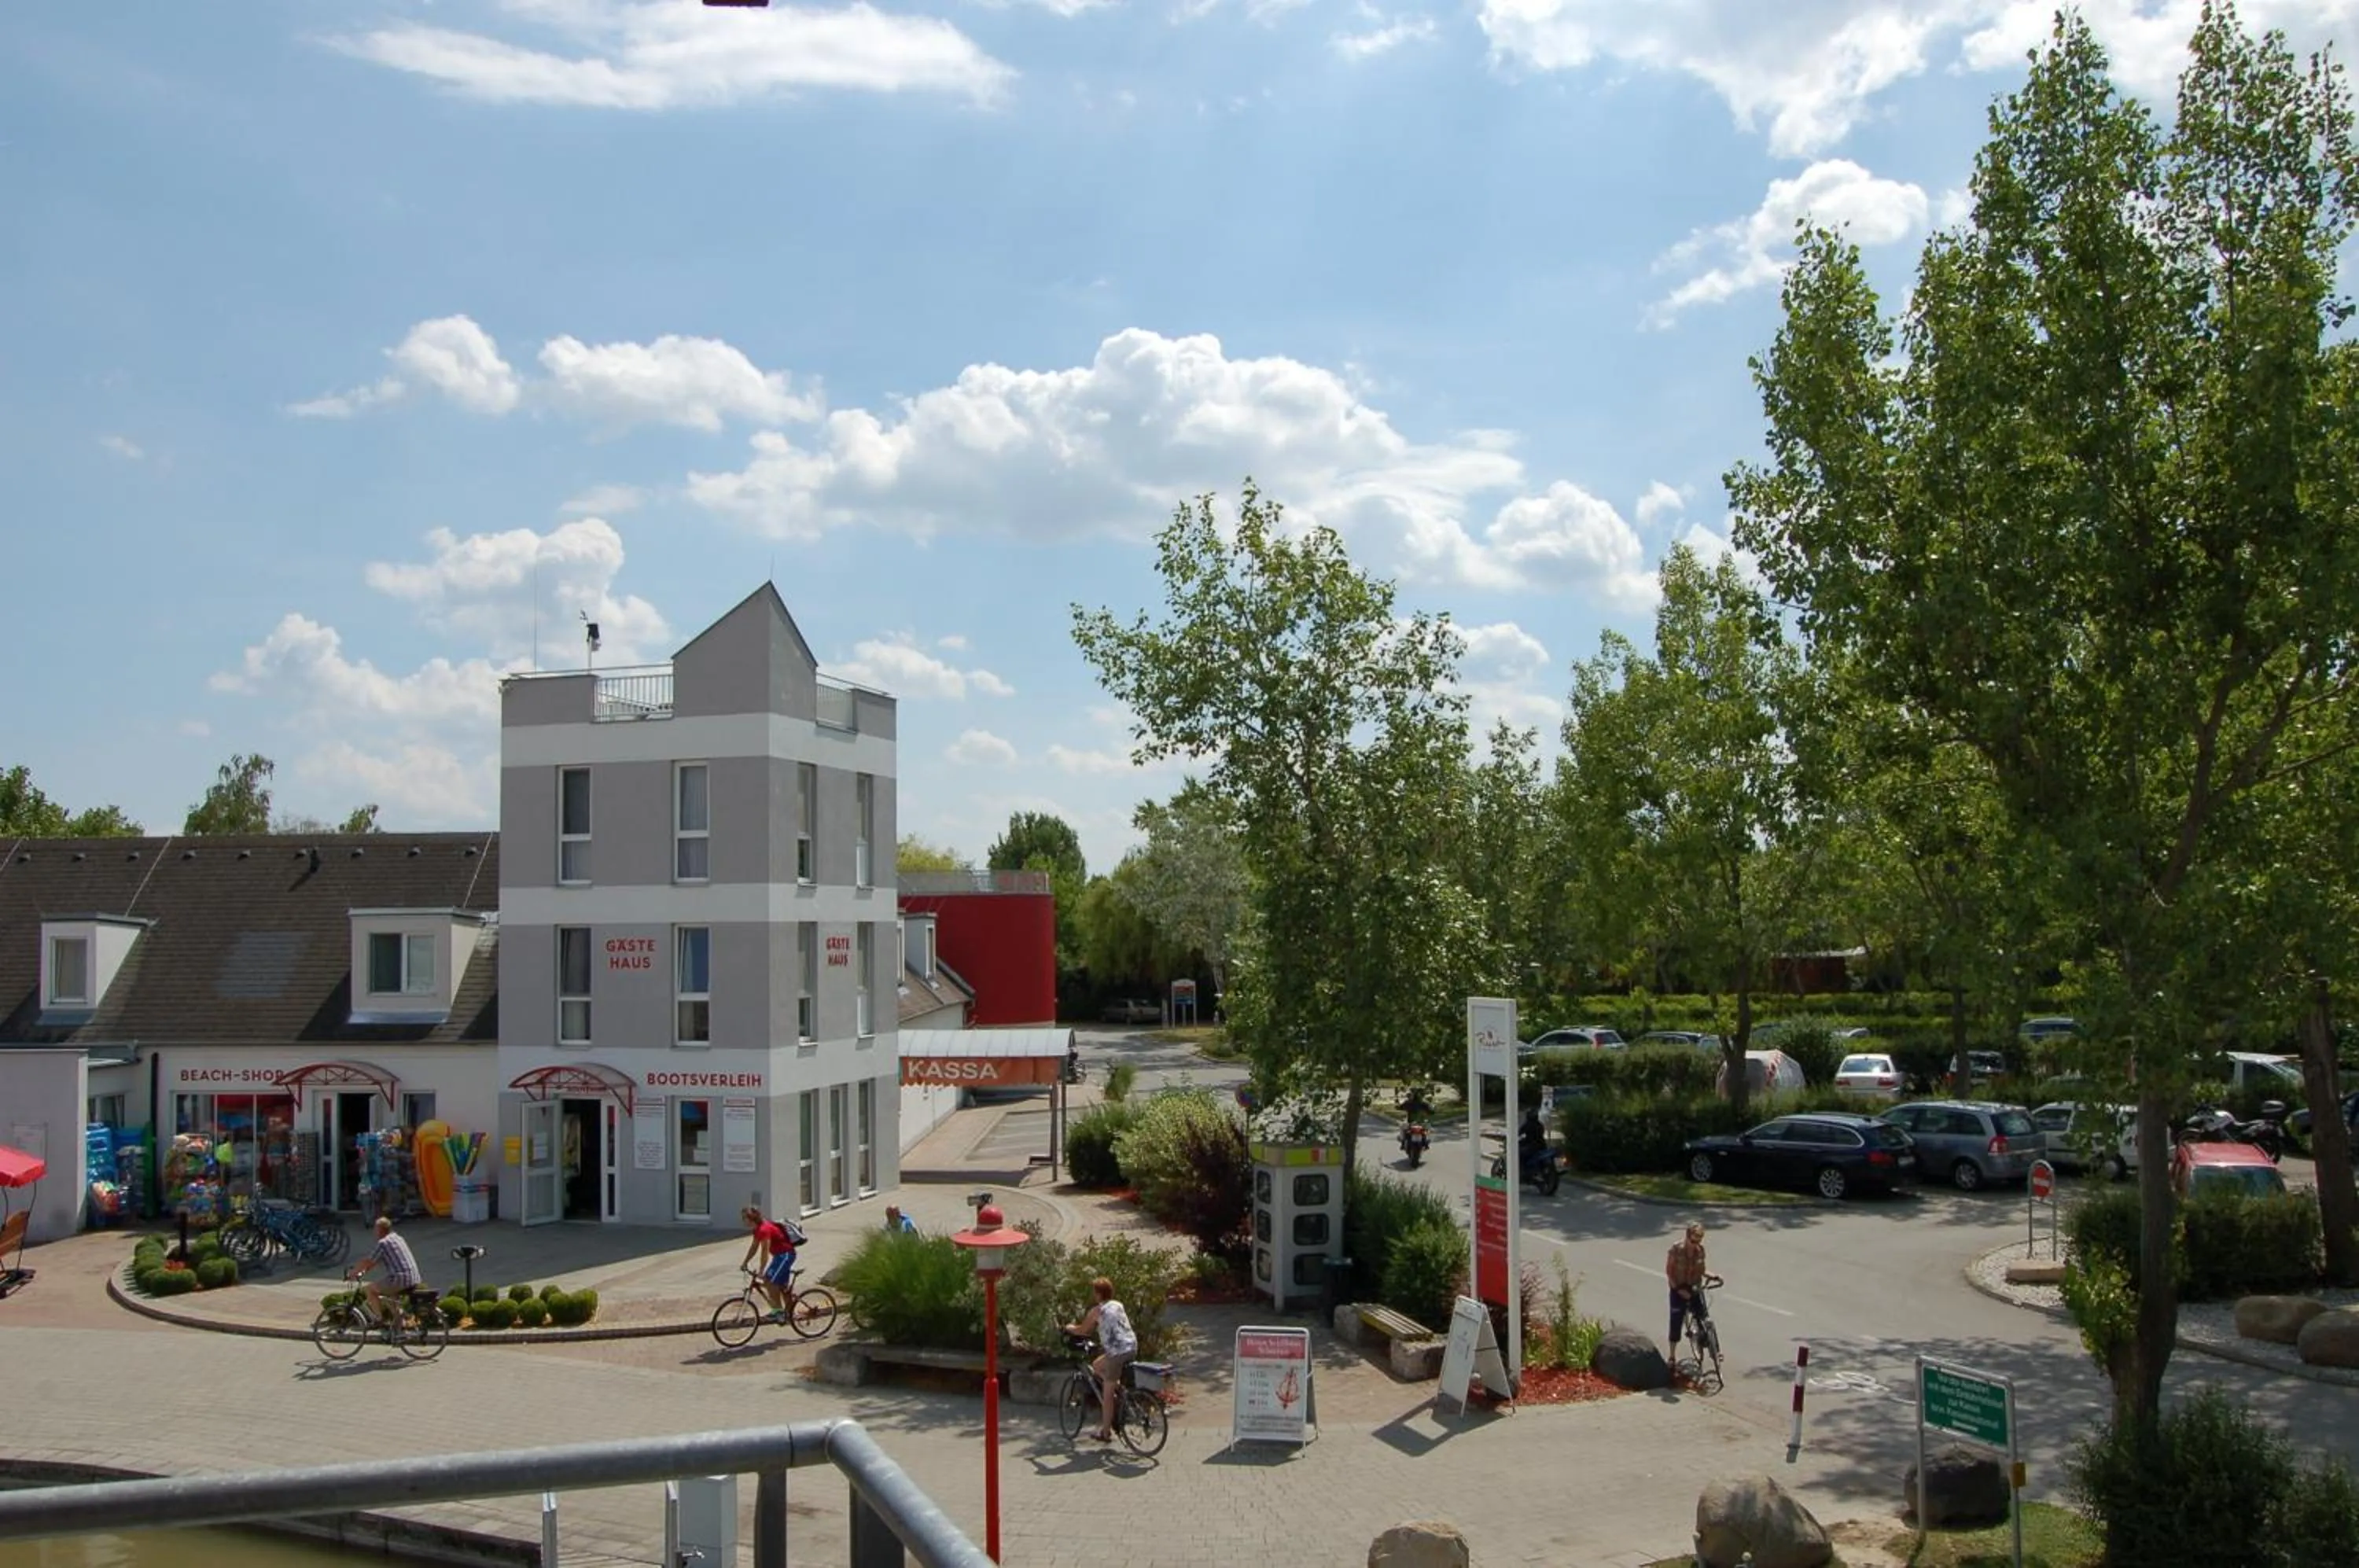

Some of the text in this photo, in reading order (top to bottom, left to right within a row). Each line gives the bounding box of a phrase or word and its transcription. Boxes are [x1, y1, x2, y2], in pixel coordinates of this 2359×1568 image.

[606, 938, 656, 953] GÄSTE
[609, 956, 651, 970] HAUS
[180, 1069, 284, 1081] BEACH-SHOP
[908, 1060, 998, 1080] KASSA
[647, 1072, 762, 1088] BOOTSVERLEIH
